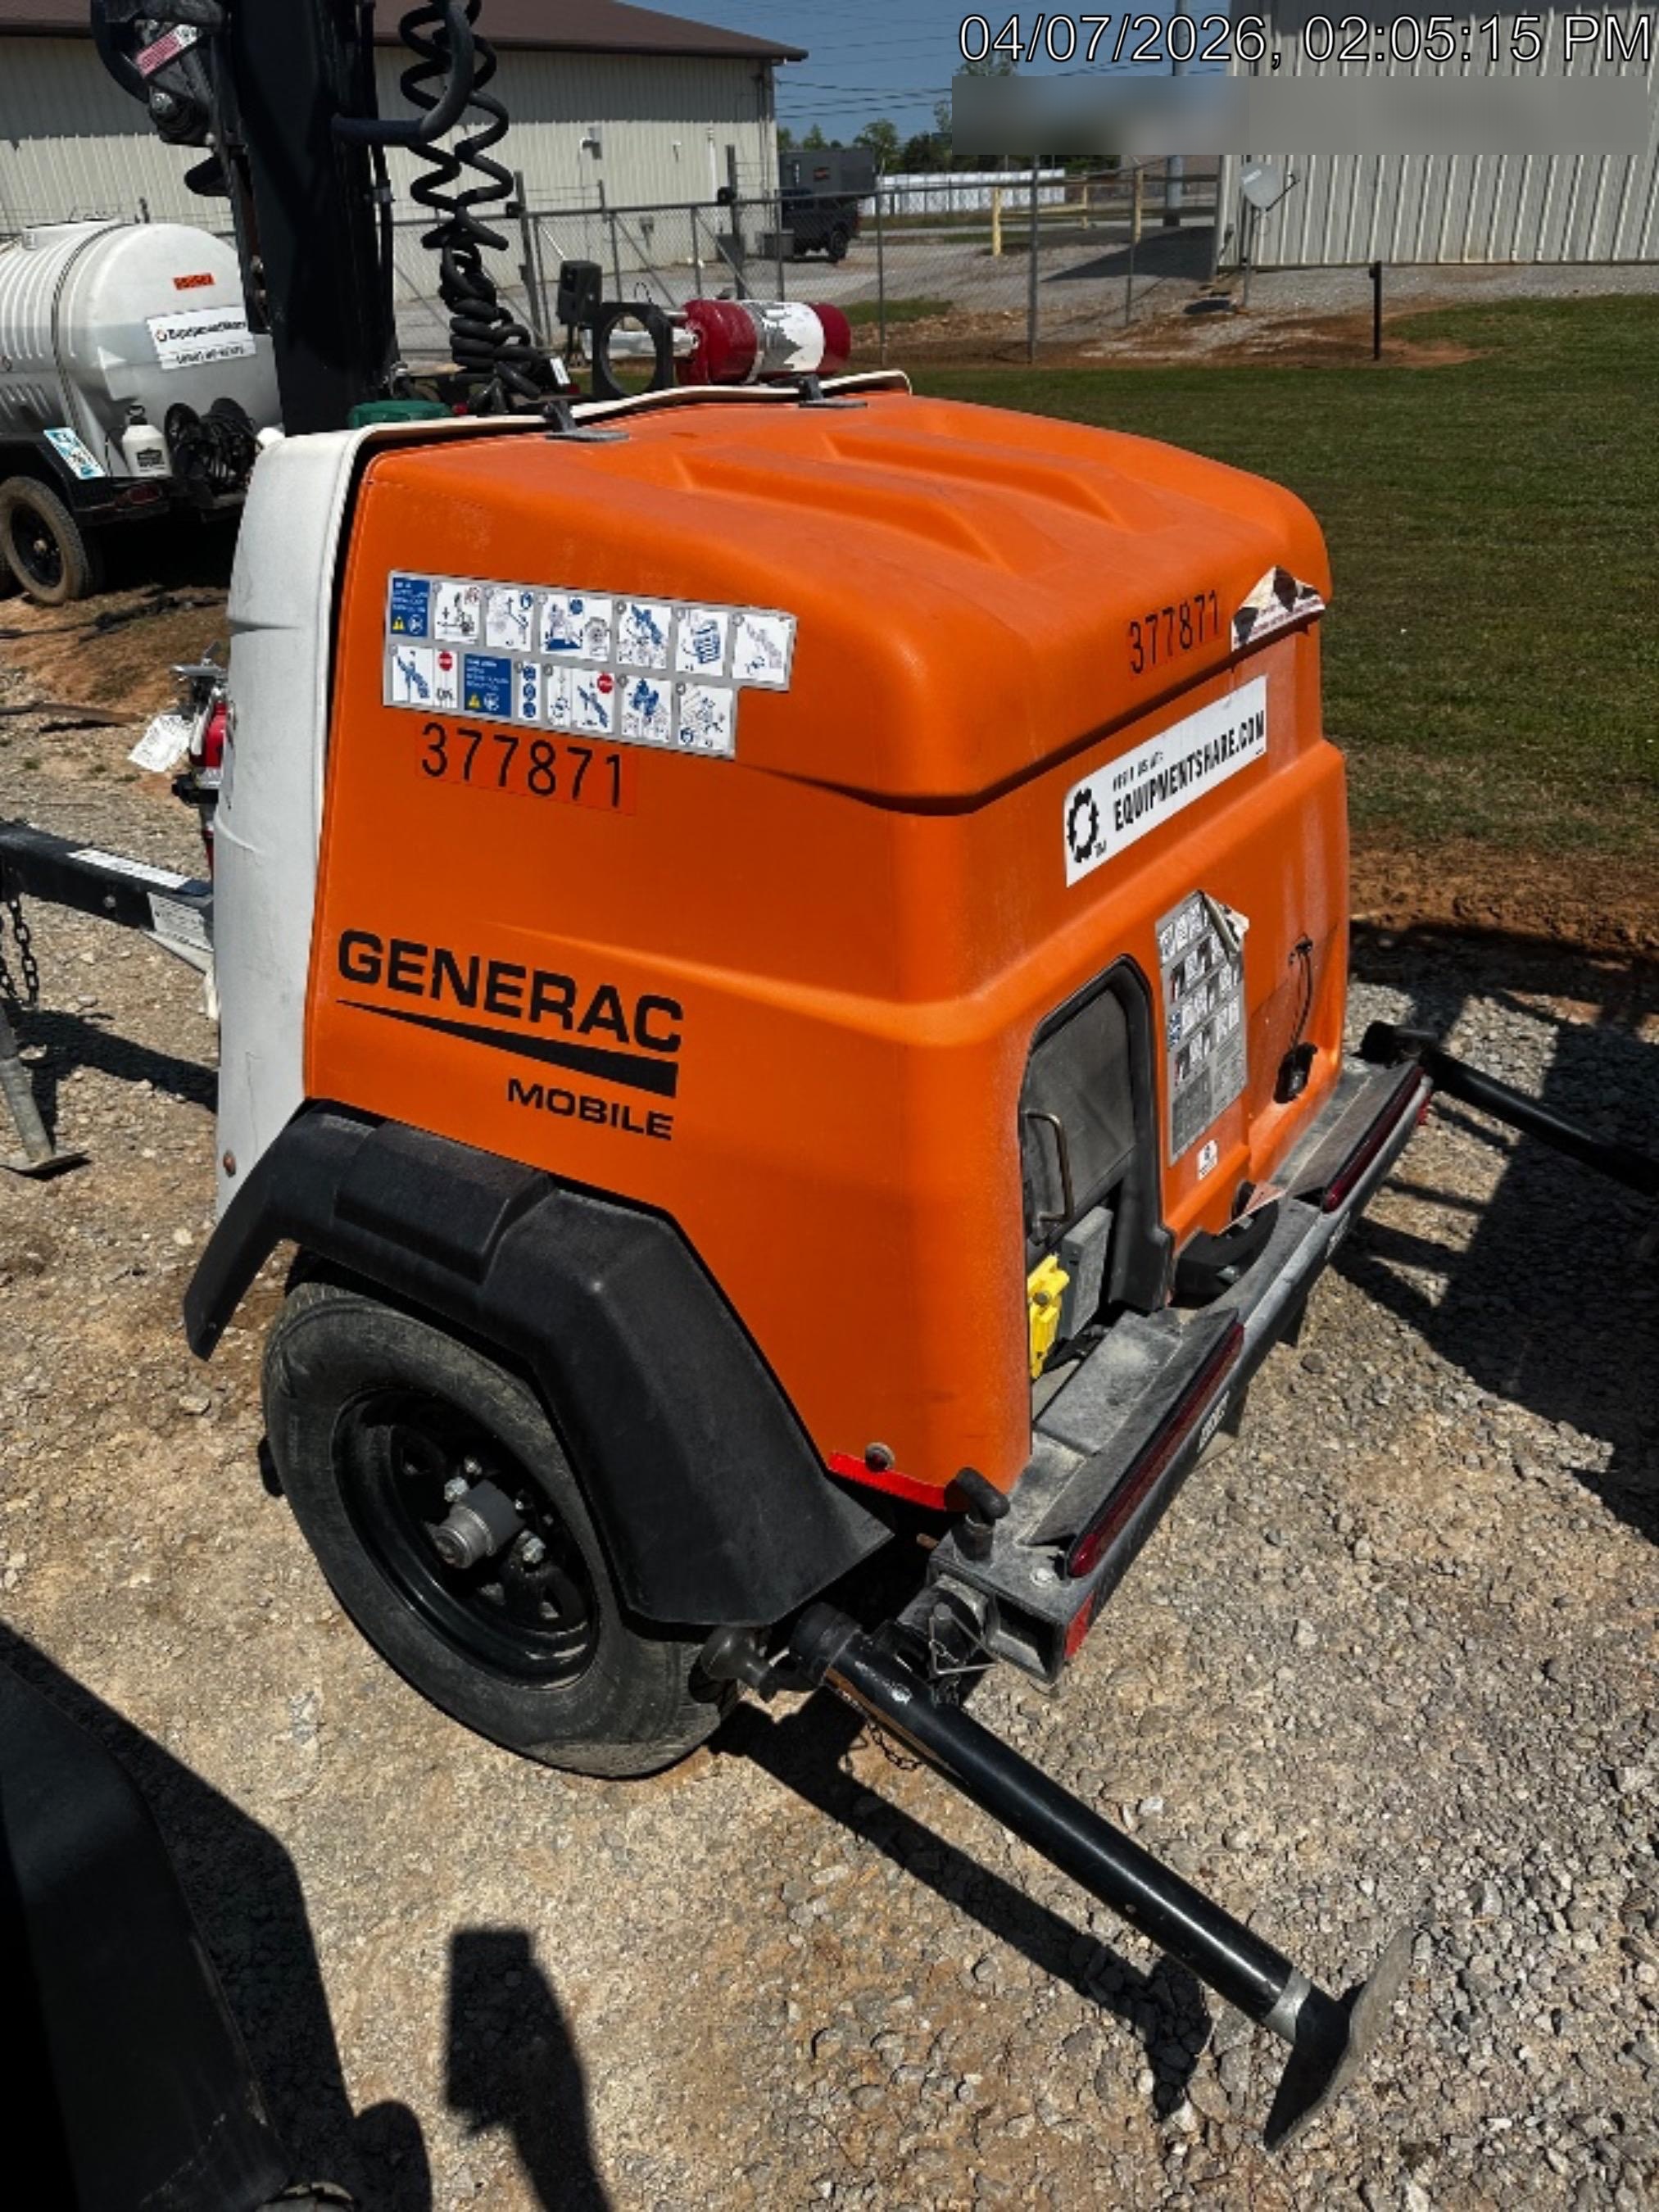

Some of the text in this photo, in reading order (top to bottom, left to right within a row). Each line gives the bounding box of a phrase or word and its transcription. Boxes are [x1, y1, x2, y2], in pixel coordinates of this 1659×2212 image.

[1129, 589, 1219, 674] 377871
[421, 722, 621, 808] 377871
[1113, 709, 1264, 831] EQUIPMENTSHARE.COM
[338, 928, 683, 1053] GENERAC
[507, 1077, 674, 1140] MOBILE
